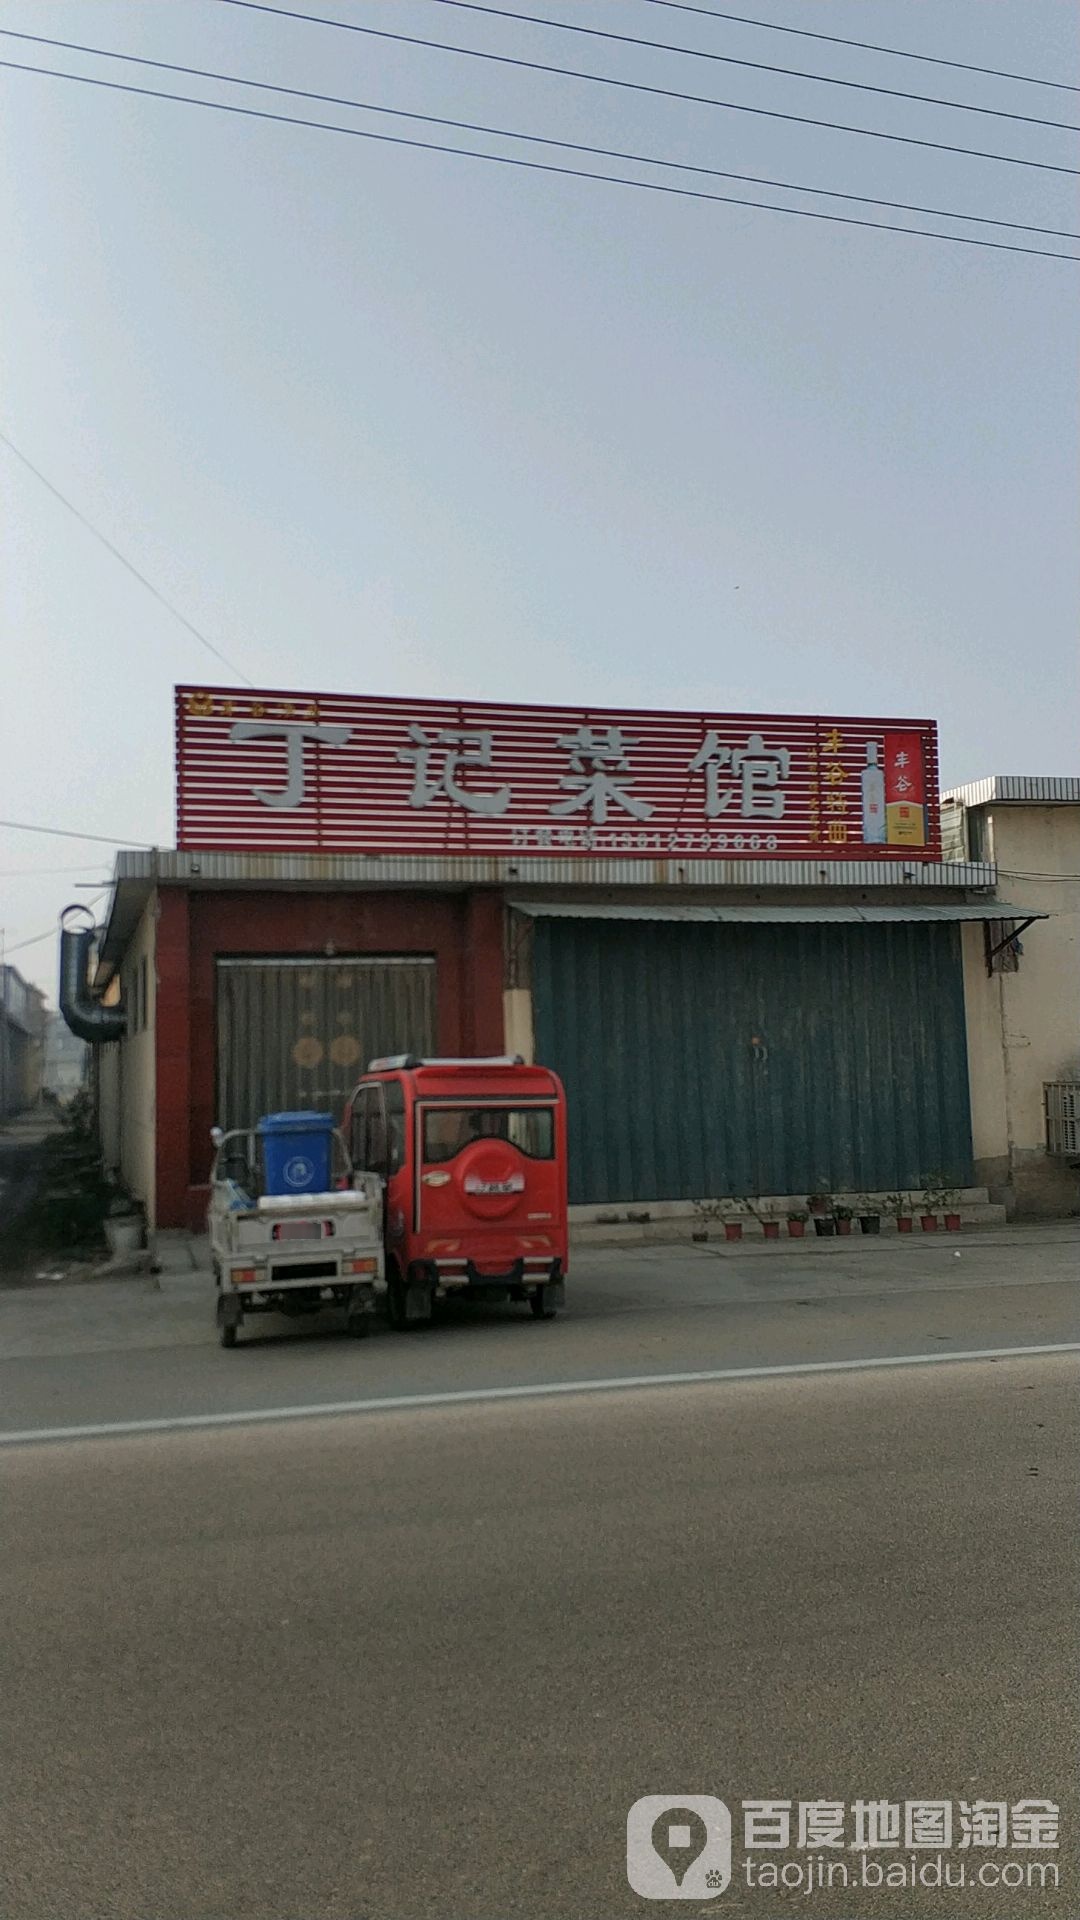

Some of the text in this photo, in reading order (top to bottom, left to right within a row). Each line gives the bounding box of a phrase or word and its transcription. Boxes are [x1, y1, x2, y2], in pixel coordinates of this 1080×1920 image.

[228, 722, 791, 825] 丁记菜馆
[822, 728, 849, 844] 丰谷特曲
[893, 751, 913, 792] 丰谷
